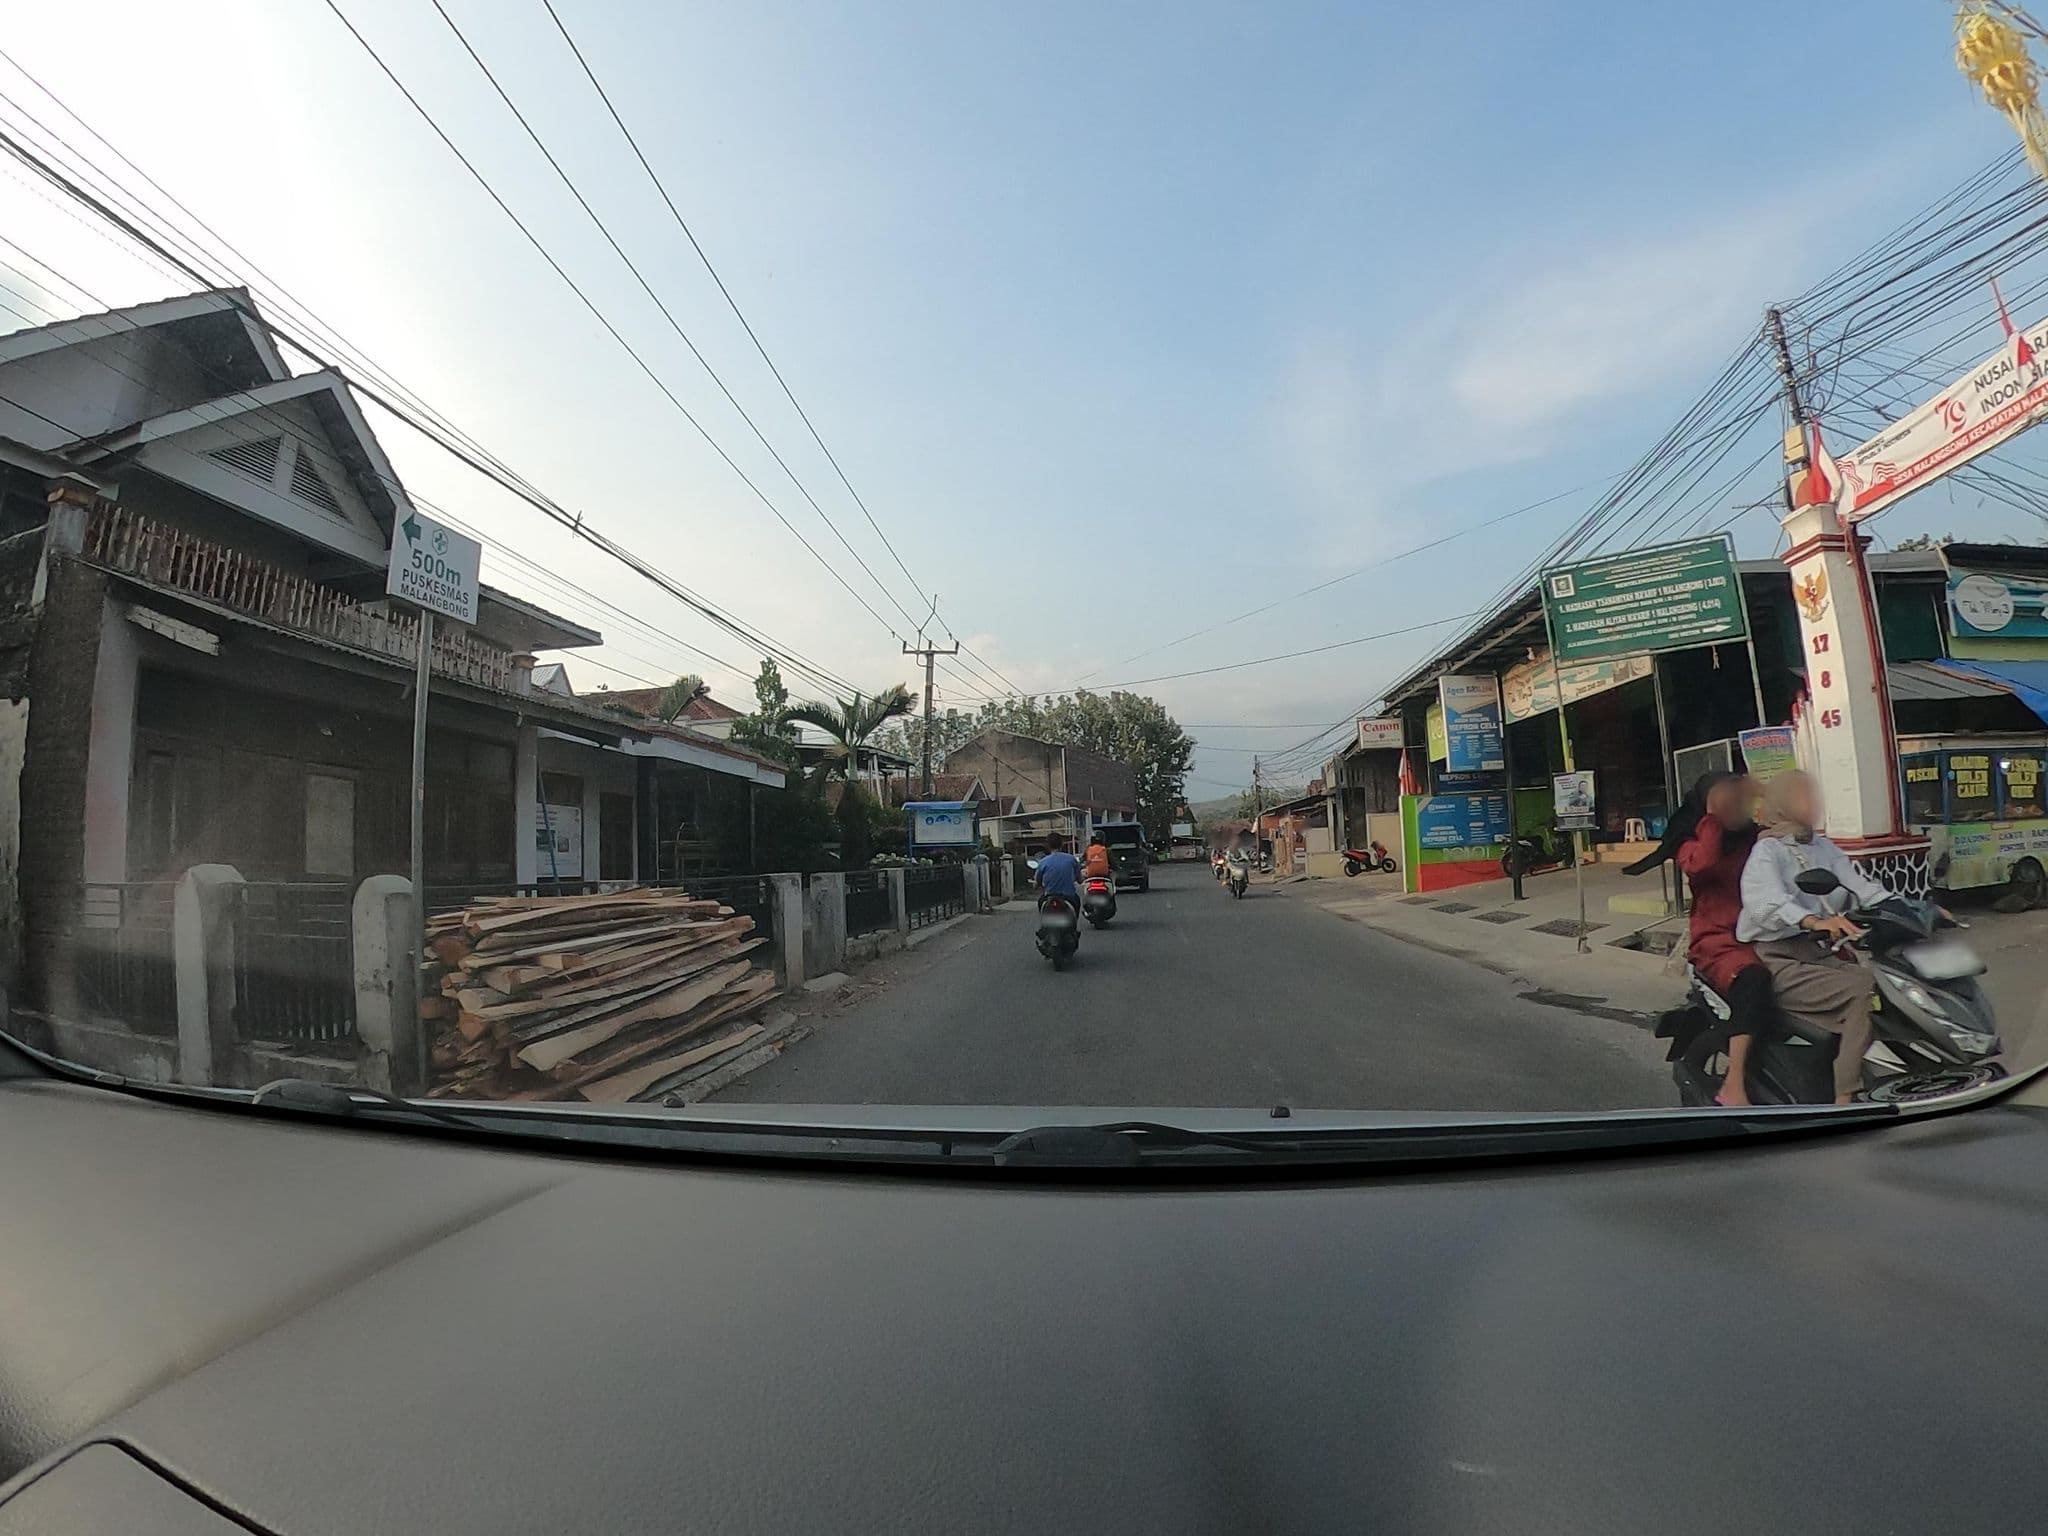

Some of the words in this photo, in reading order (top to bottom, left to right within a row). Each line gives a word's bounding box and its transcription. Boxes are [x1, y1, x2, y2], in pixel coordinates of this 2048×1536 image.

[1935, 396, 1967, 434] 79
[1968, 403, 2022, 441] KECAMATAN
[411, 548, 461, 586] 500m
[400, 583, 469, 618] MALANGBONG
[402, 568, 469, 605] PUSKESMAS
[1812, 633, 1829, 654] 17
[1820, 671, 1831, 688] 8
[1363, 722, 1400, 732] Canon
[1480, 721, 1498, 730] CELL
[1820, 709, 1841, 729] 45
